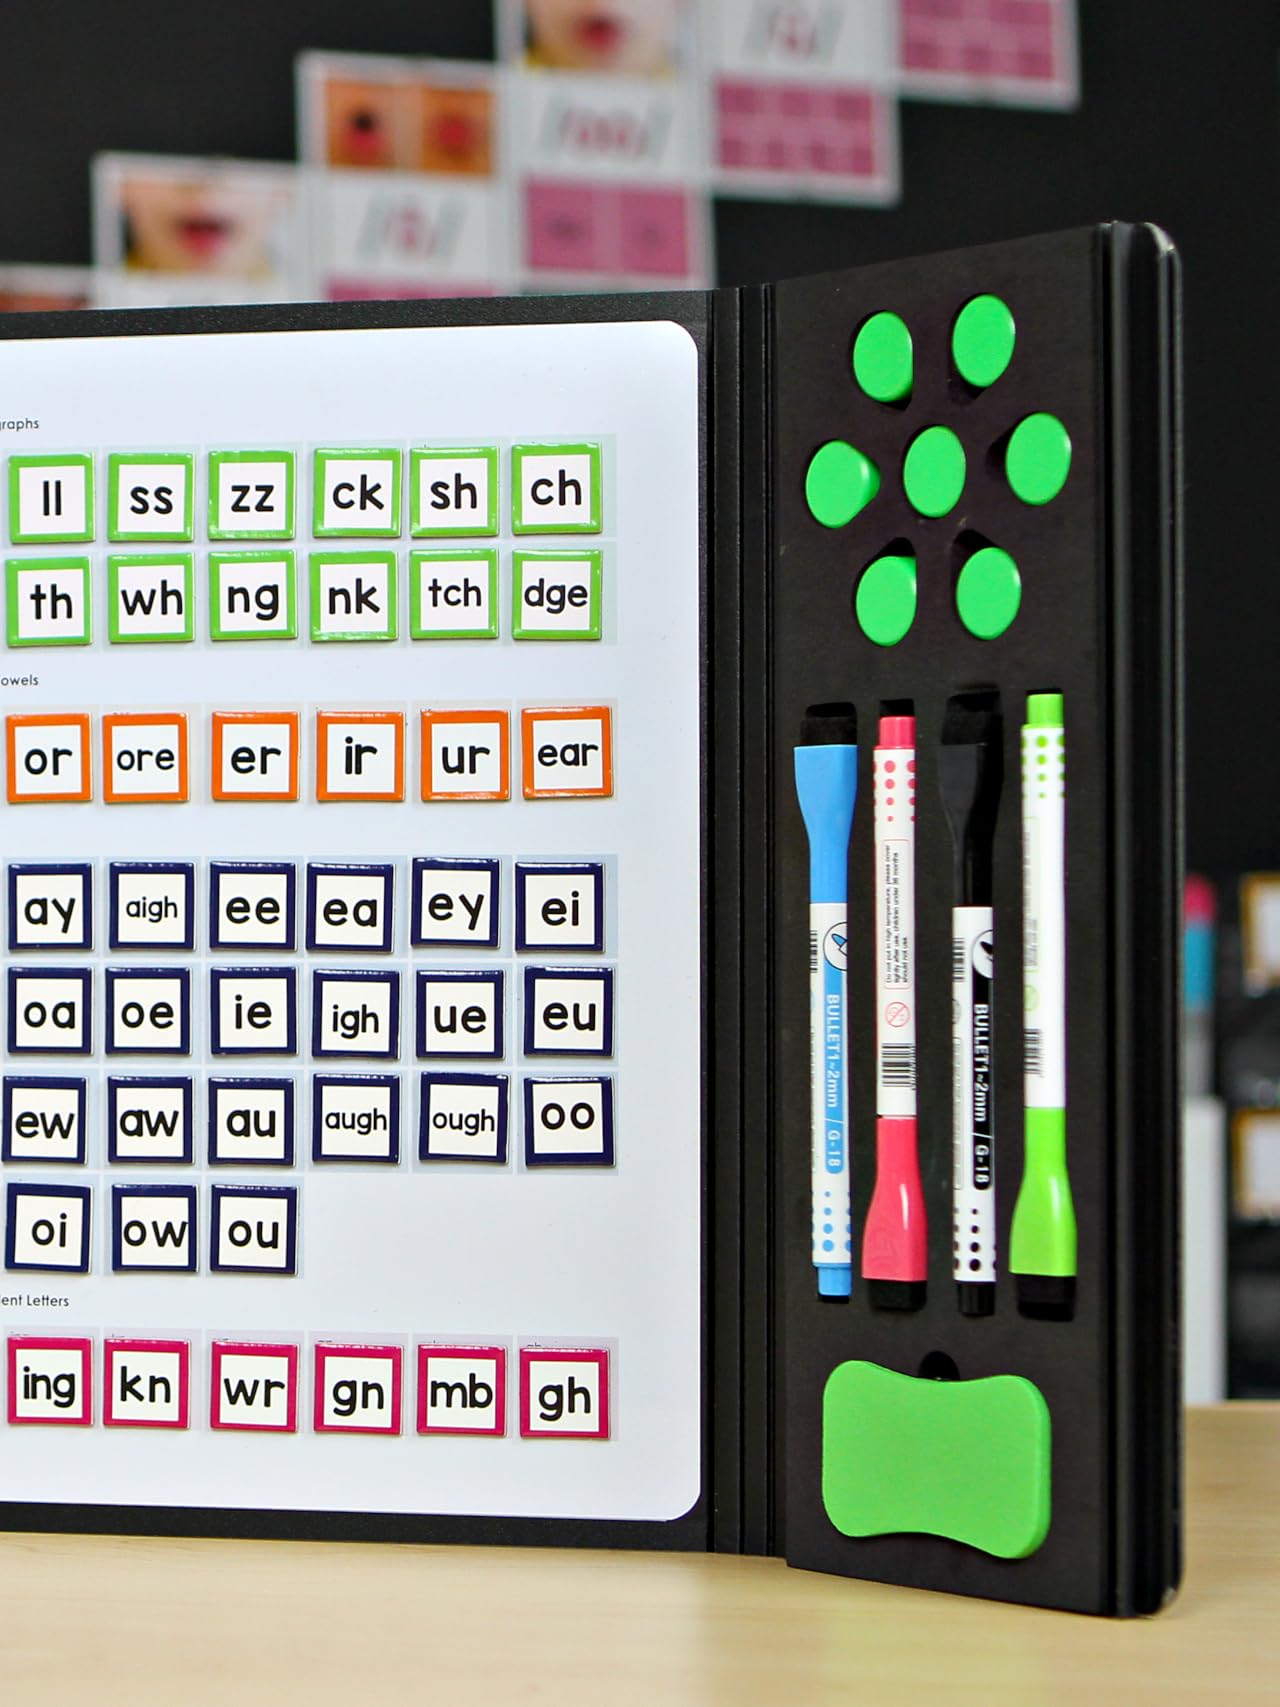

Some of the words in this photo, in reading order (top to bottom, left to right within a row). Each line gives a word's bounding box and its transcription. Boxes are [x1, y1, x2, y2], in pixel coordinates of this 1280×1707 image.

[130, 486, 173, 515] ss
[231, 484, 275, 513] zz
[332, 474, 385, 511] ck
[430, 472, 477, 510] sh
[530, 469, 582, 506] ch
[29, 583, 73, 620] th
[121, 579, 183, 616] wh
[227, 584, 279, 621] ng
[328, 577, 380, 615] nk
[428, 577, 482, 608] tch
[524, 577, 588, 615] dge
[24, 747, 73, 776] or
[116, 748, 175, 772] ore
[230, 746, 282, 775] er
[344, 736, 378, 775] ir
[441, 745, 491, 775] ur
[537, 743, 599, 767] ear
[24, 897, 76, 934] ay
[126, 895, 178, 924] aigh
[225, 896, 280, 925] ee
[323, 898, 378, 928] ea
[428, 893, 485, 931] ey
[541, 890, 580, 927] ei
[23, 1001, 76, 1030] oa
[121, 1001, 174, 1029] oe
[235, 994, 272, 1030] ie
[332, 1003, 379, 1040] igh
[434, 1005, 487, 1034] ue
[542, 1002, 596, 1032] eu
[15, 1111, 75, 1140] ew
[119, 1109, 179, 1138] aw
[226, 1109, 276, 1138] au
[325, 1107, 387, 1136] augh
[432, 1108, 495, 1137] ough
[540, 1102, 595, 1131] oo
[827, 1130, 841, 1168] G-18
[974, 1145, 990, 1184] G-18
[31, 1212, 68, 1248] oi
[122, 1219, 188, 1250] ow
[228, 1220, 279, 1250] ou
[26, 1295, 69, 1307] Letters
[23, 1365, 76, 1409] ing
[120, 1365, 171, 1404] kn
[223, 1378, 286, 1408] wr
[332, 1379, 384, 1417] gn
[430, 1372, 493, 1409] mb
[538, 1376, 591, 1422] gh
